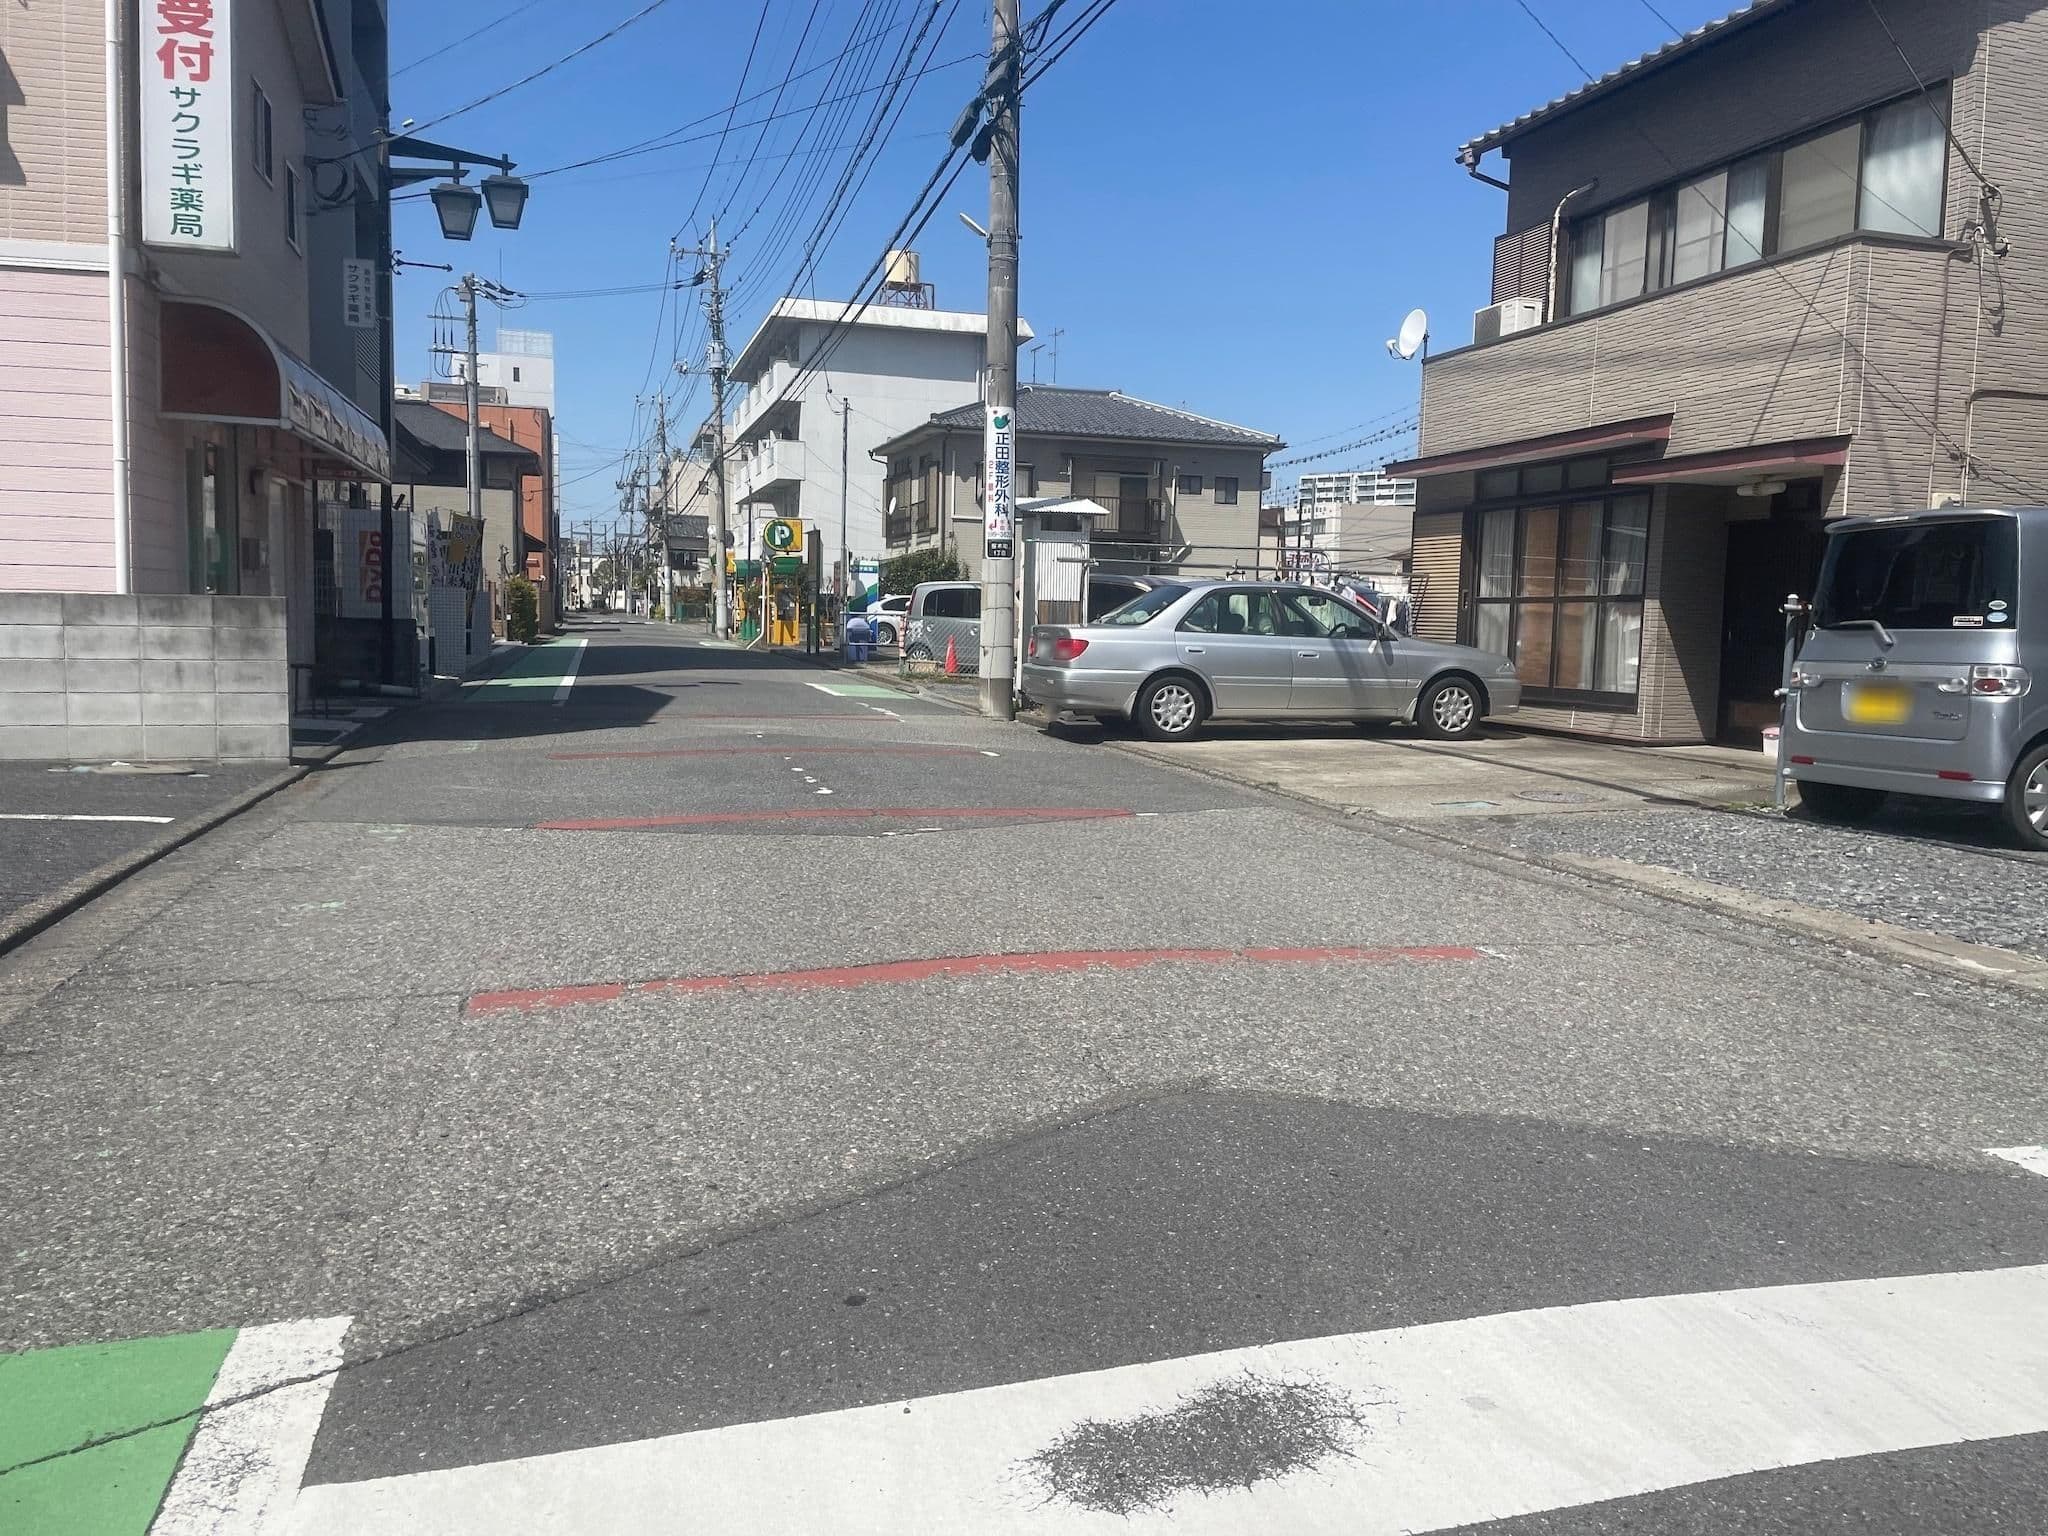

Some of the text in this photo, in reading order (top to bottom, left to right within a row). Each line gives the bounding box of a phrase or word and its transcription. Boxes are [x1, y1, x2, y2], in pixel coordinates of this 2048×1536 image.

[157, 0, 213, 82] 受付
[170, 86, 203, 238] サクラギ薬局
[348, 265, 359, 323] サクラギ薬局
[995, 432, 1010, 517] 正田整形外科
[774, 525, 790, 545] P
